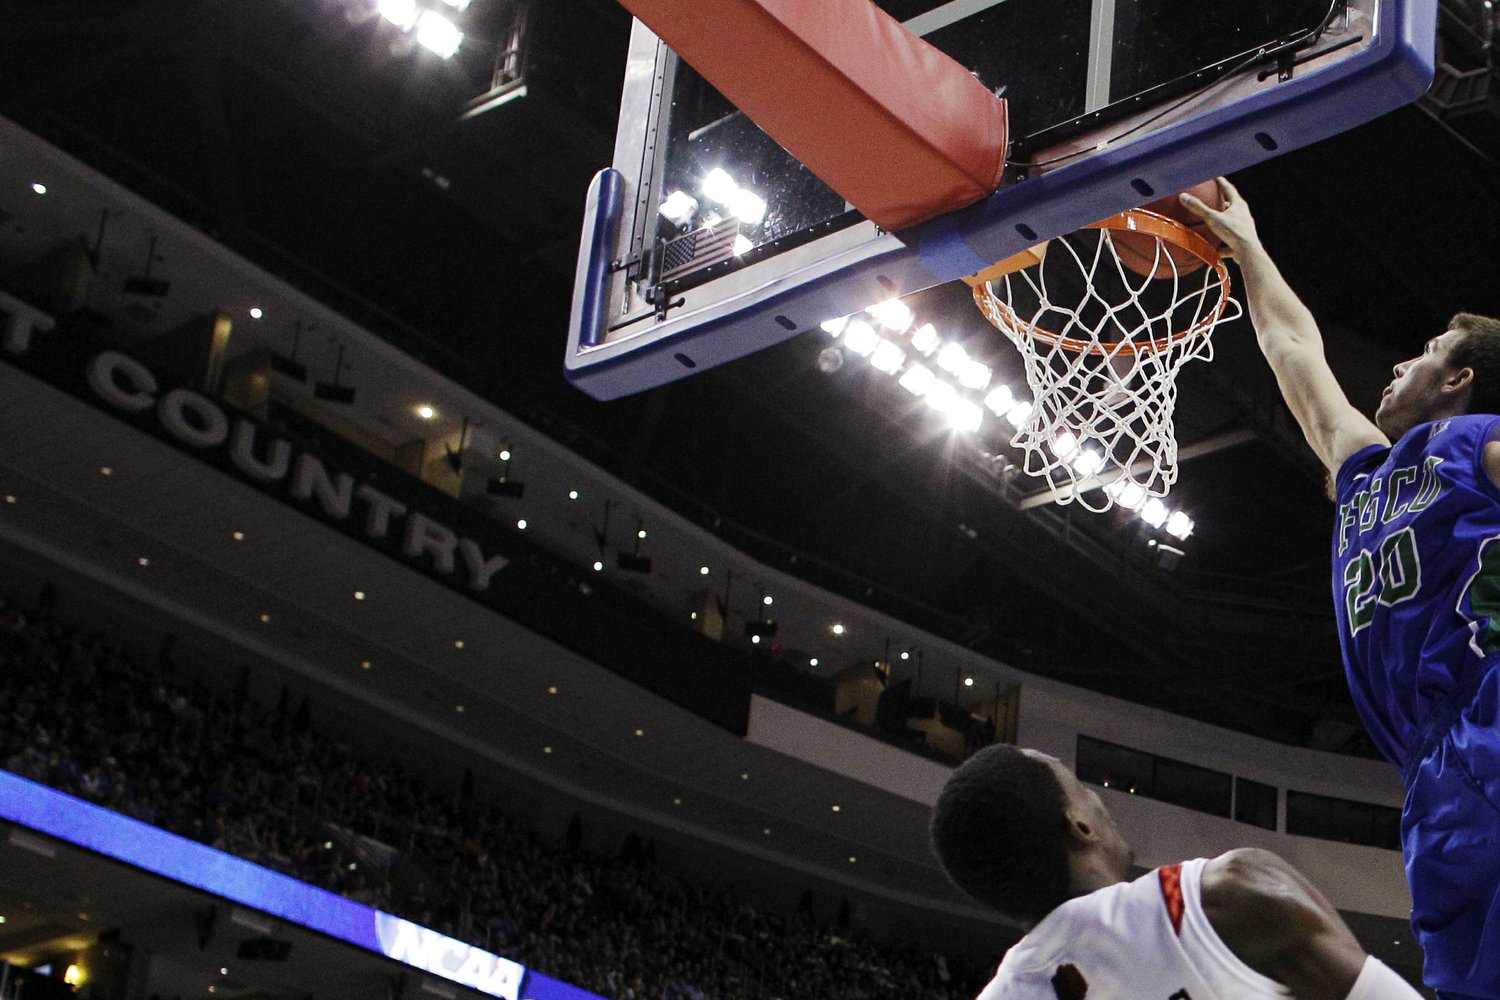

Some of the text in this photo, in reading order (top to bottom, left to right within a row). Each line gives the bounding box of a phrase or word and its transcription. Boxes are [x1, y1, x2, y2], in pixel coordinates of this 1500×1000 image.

[86, 350, 510, 591] COUNTRY
[1338, 455, 1445, 558] FGCU
[1343, 525, 1422, 638] 20
